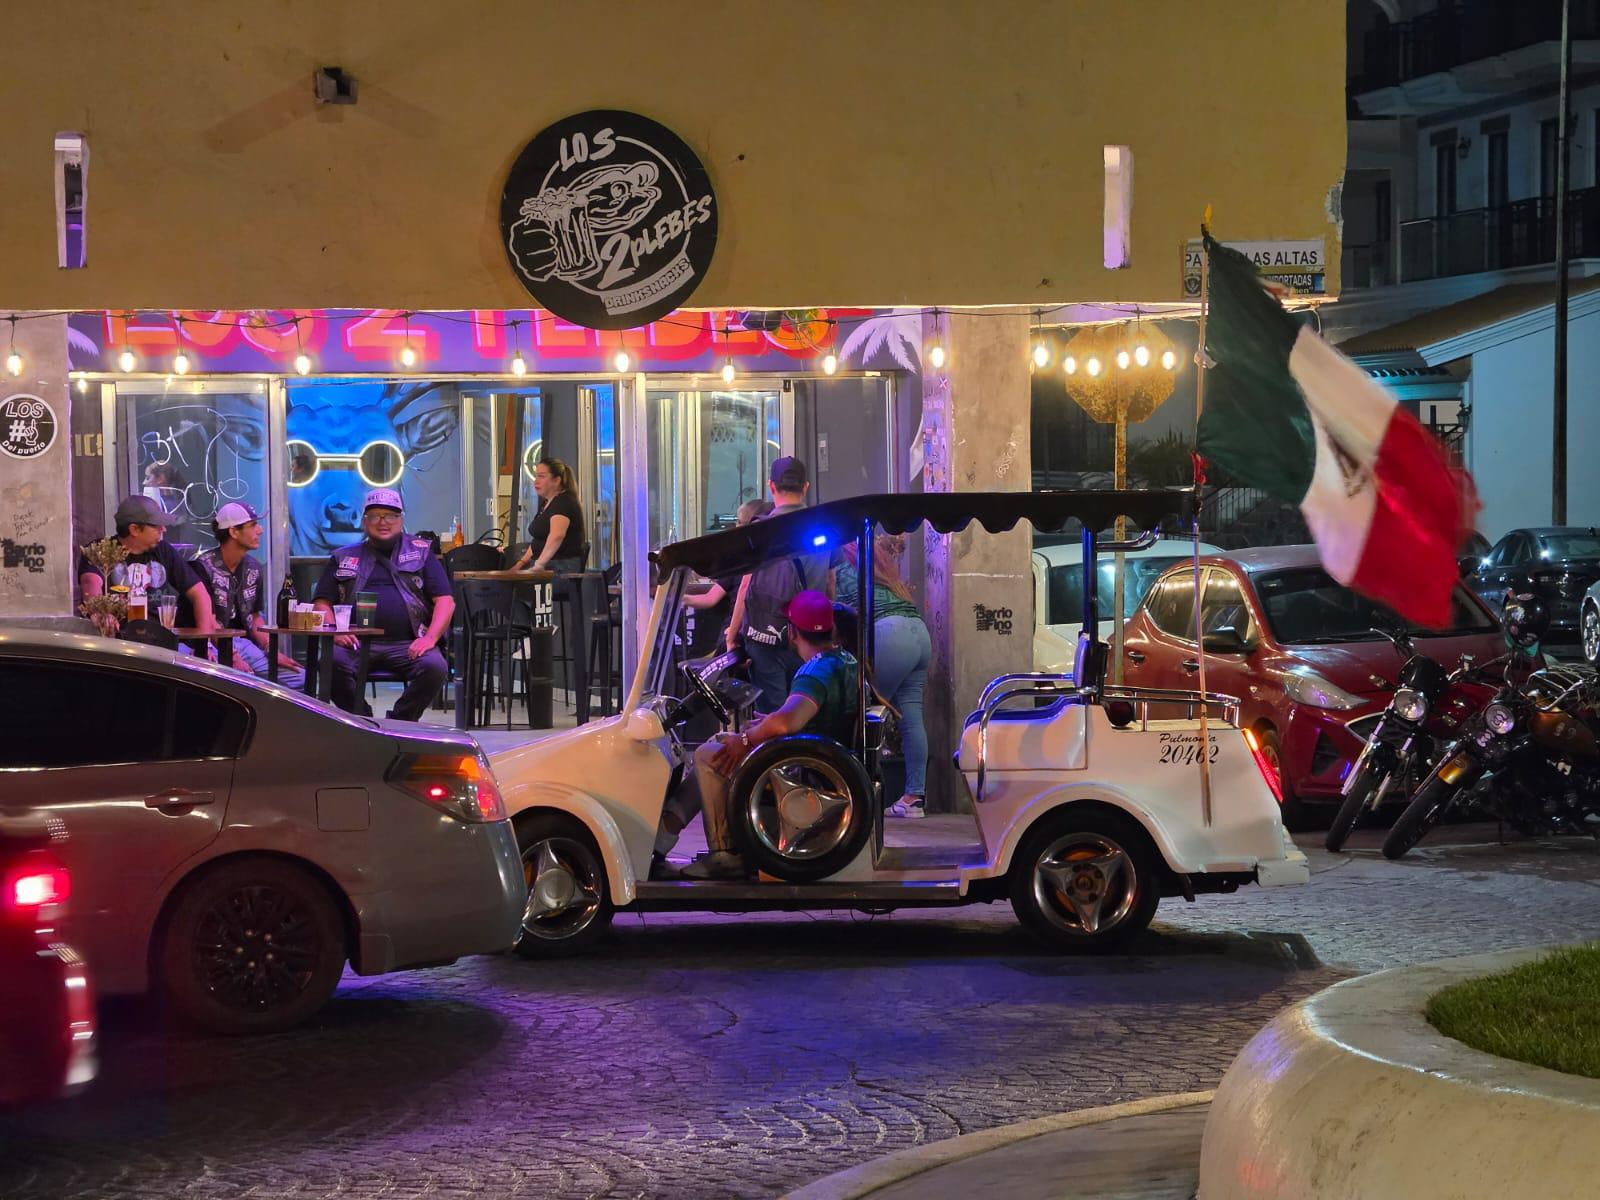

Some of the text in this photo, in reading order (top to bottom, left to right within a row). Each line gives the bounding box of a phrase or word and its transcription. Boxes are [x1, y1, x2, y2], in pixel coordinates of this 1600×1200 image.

[559, 127, 616, 172] LOS
[1275, 251, 1317, 265] ALTAS
[5, 401, 45, 418] LOS
[2, 440, 46, 454] Del puerto
[1159, 744, 1219, 766] 20462
